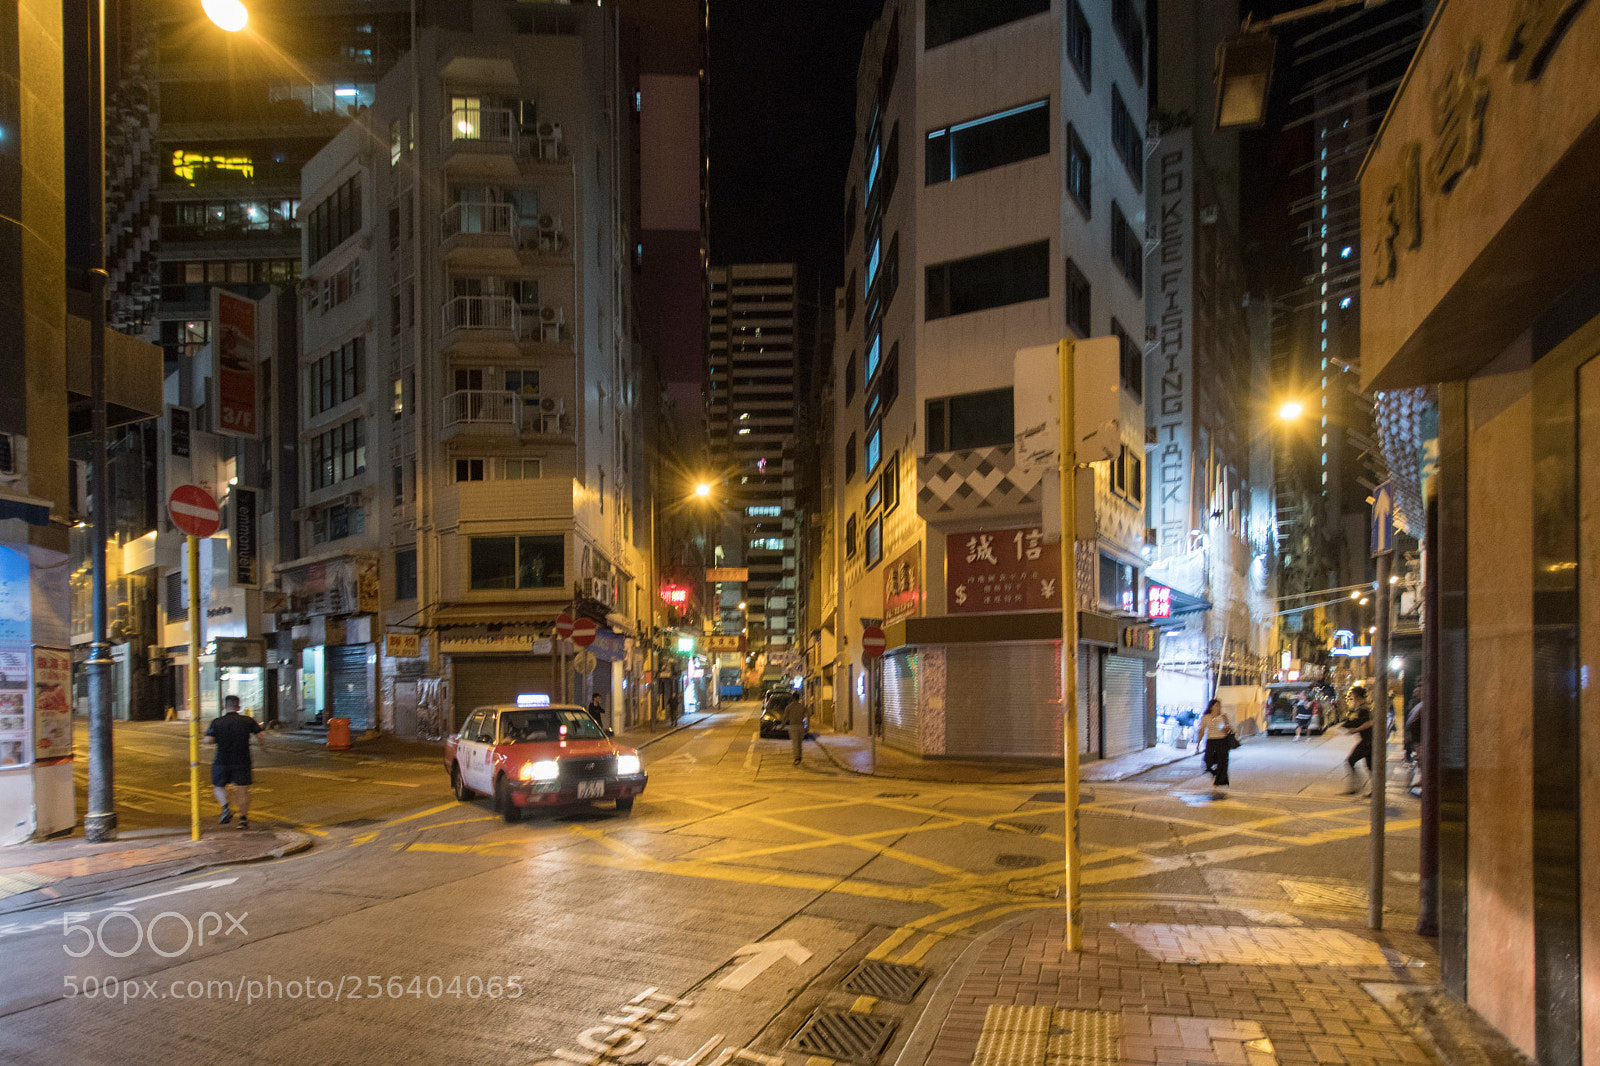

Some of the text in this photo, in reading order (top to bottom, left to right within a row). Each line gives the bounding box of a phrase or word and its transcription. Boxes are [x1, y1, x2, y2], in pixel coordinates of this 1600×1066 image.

[1160, 150, 1183, 546] POKEE FISHING TACKLE
[223, 406, 252, 428] 3/F
[965, 527, 1044, 566] 誠信
